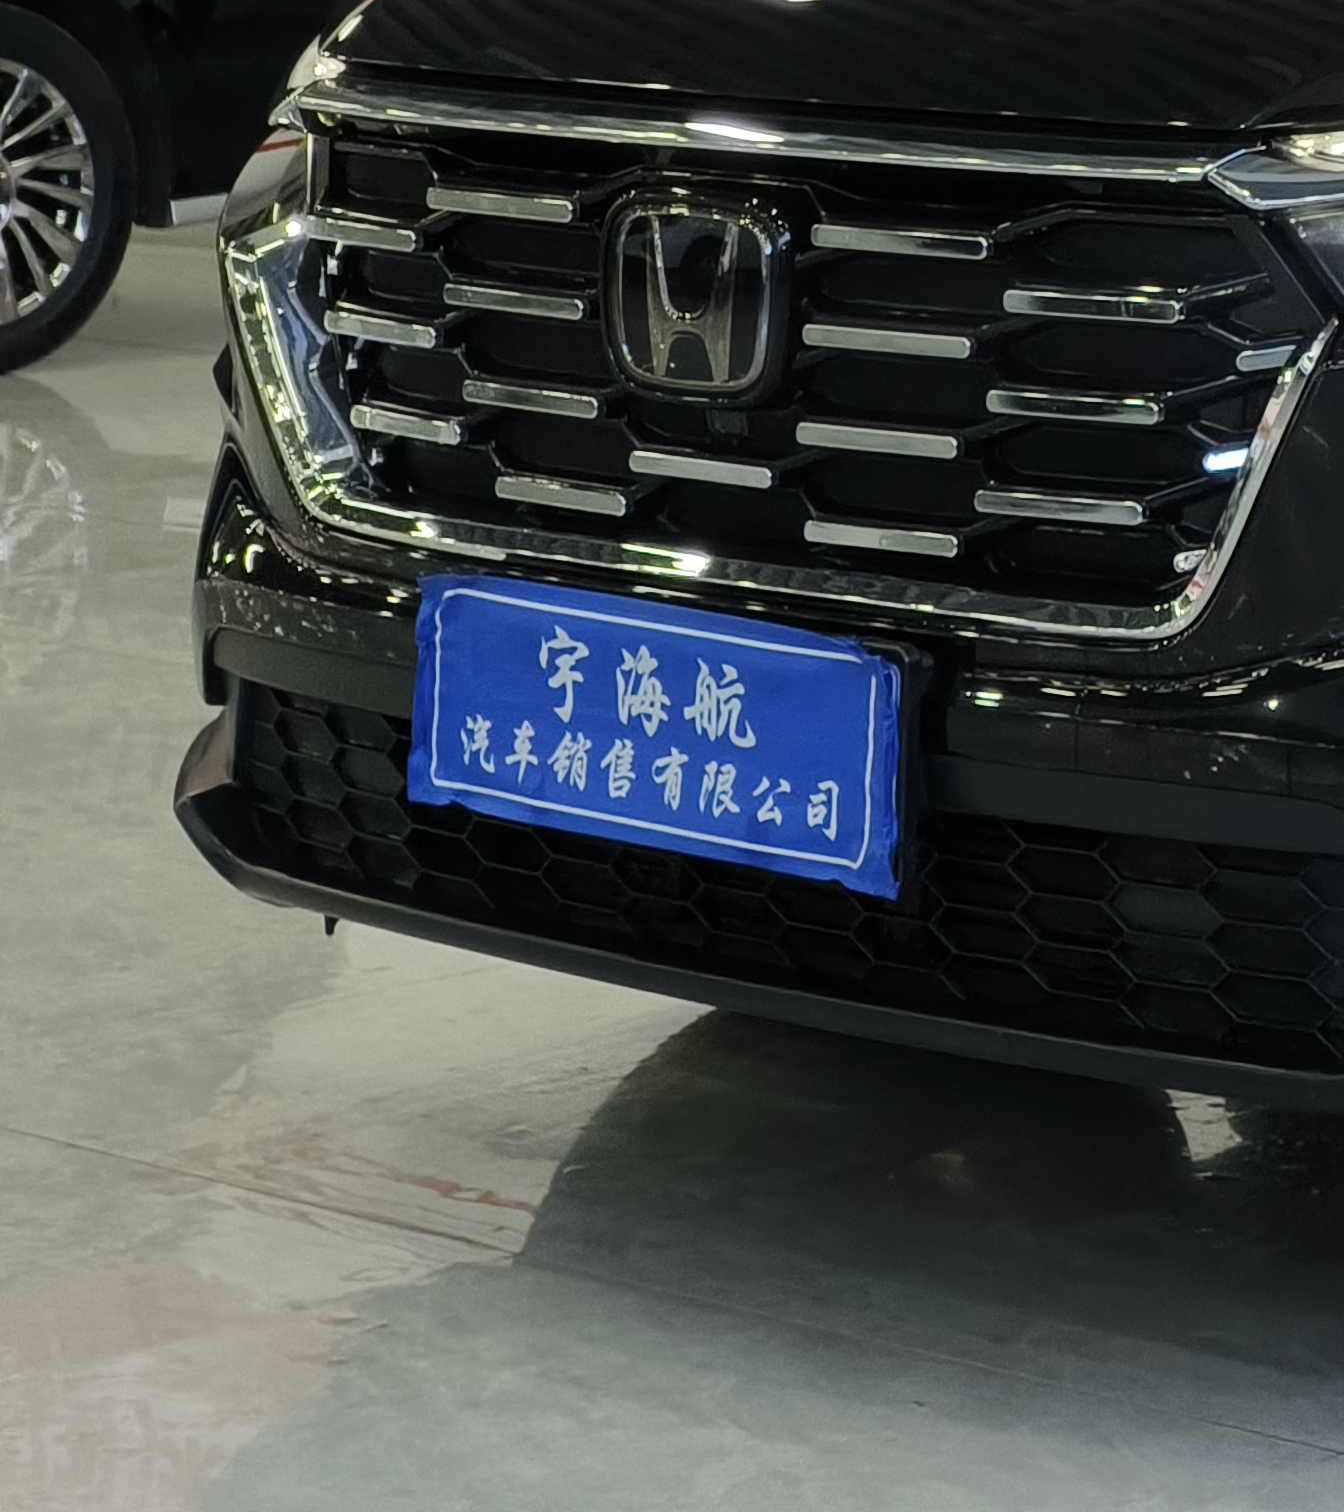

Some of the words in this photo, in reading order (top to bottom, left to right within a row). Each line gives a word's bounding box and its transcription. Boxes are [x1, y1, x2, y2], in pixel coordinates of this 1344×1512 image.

[539, 625, 757, 749] 宇海航
[459, 713, 841, 842] 汽车销售有限公司
